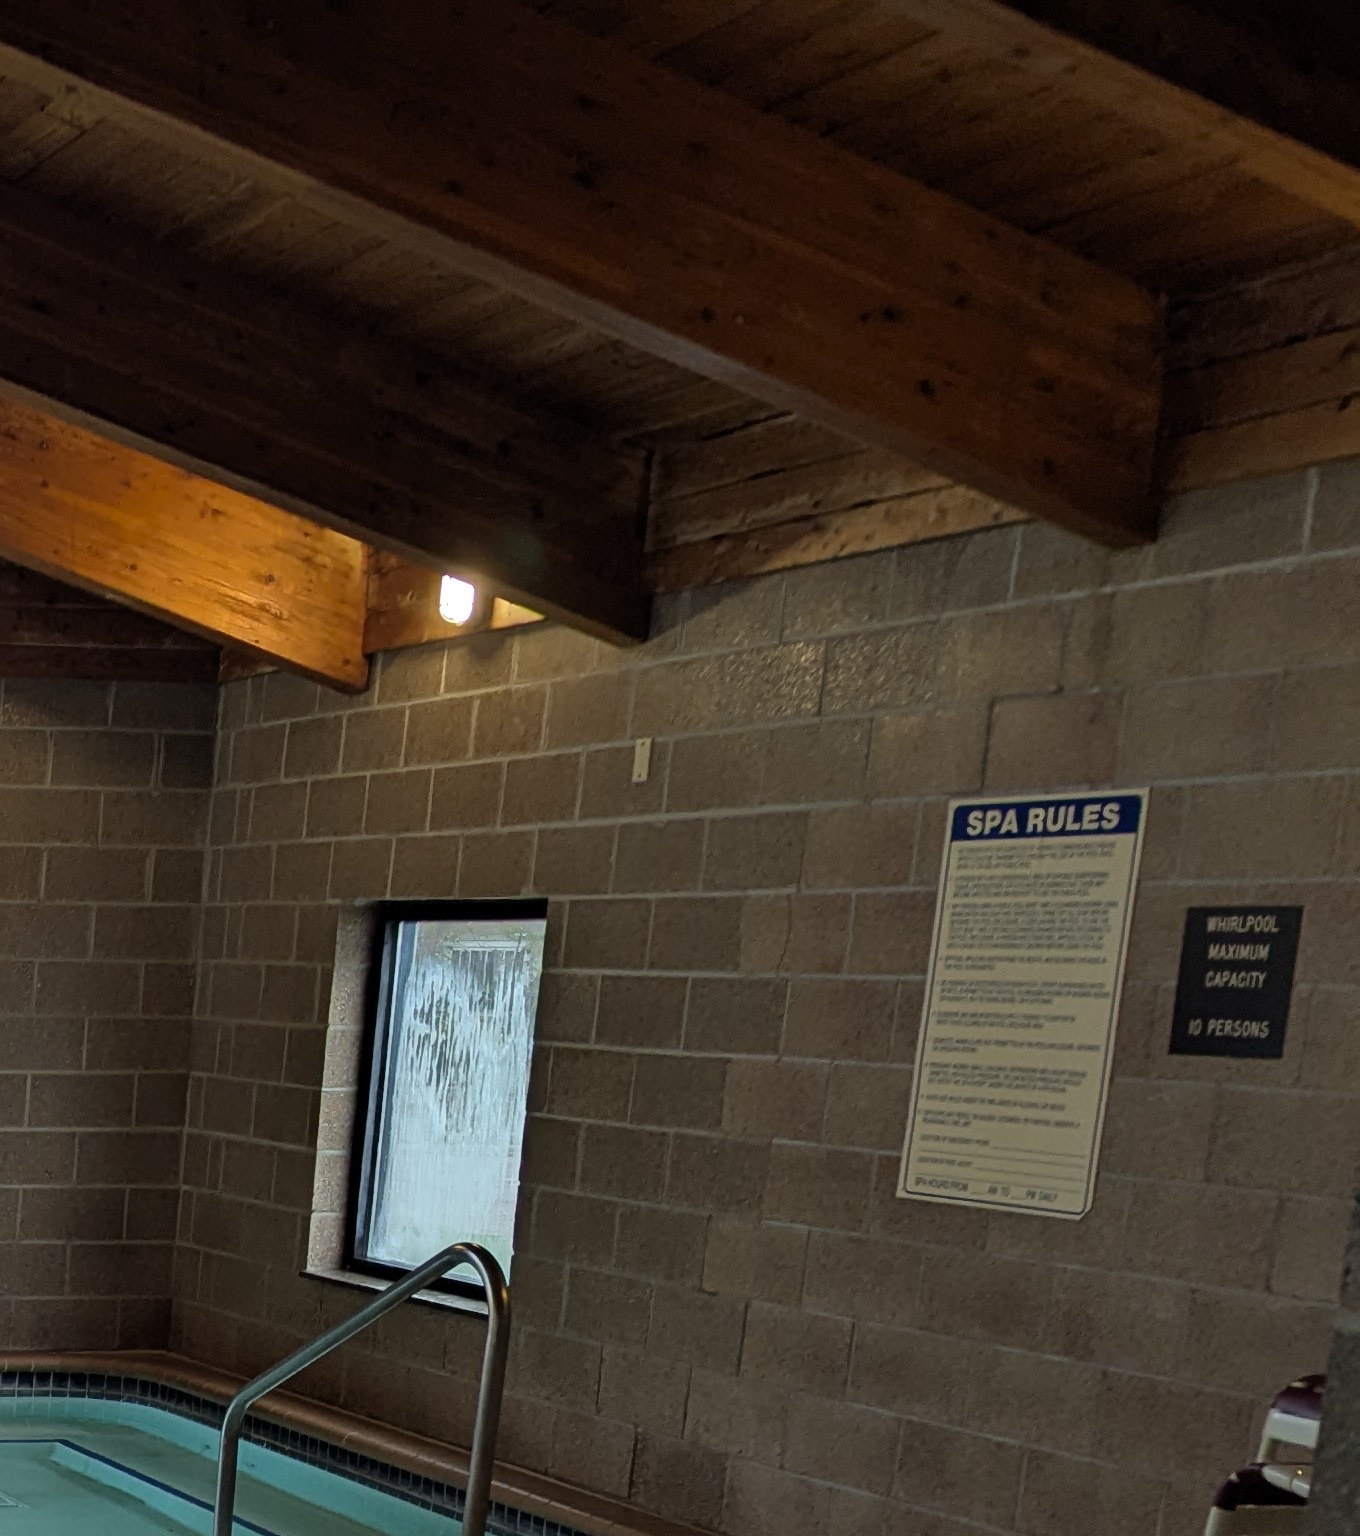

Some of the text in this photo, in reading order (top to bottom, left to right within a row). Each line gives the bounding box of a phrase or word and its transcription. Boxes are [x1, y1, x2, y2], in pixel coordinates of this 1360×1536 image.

[966, 802, 1121, 836] SPA RULES
[1206, 915, 1280, 933] WHIRLPOOL
[1207, 943, 1271, 961] MAXIMUM
[1205, 970, 1267, 988] CAPACITY
[1188, 1018, 1271, 1038] 10 PERSONS
